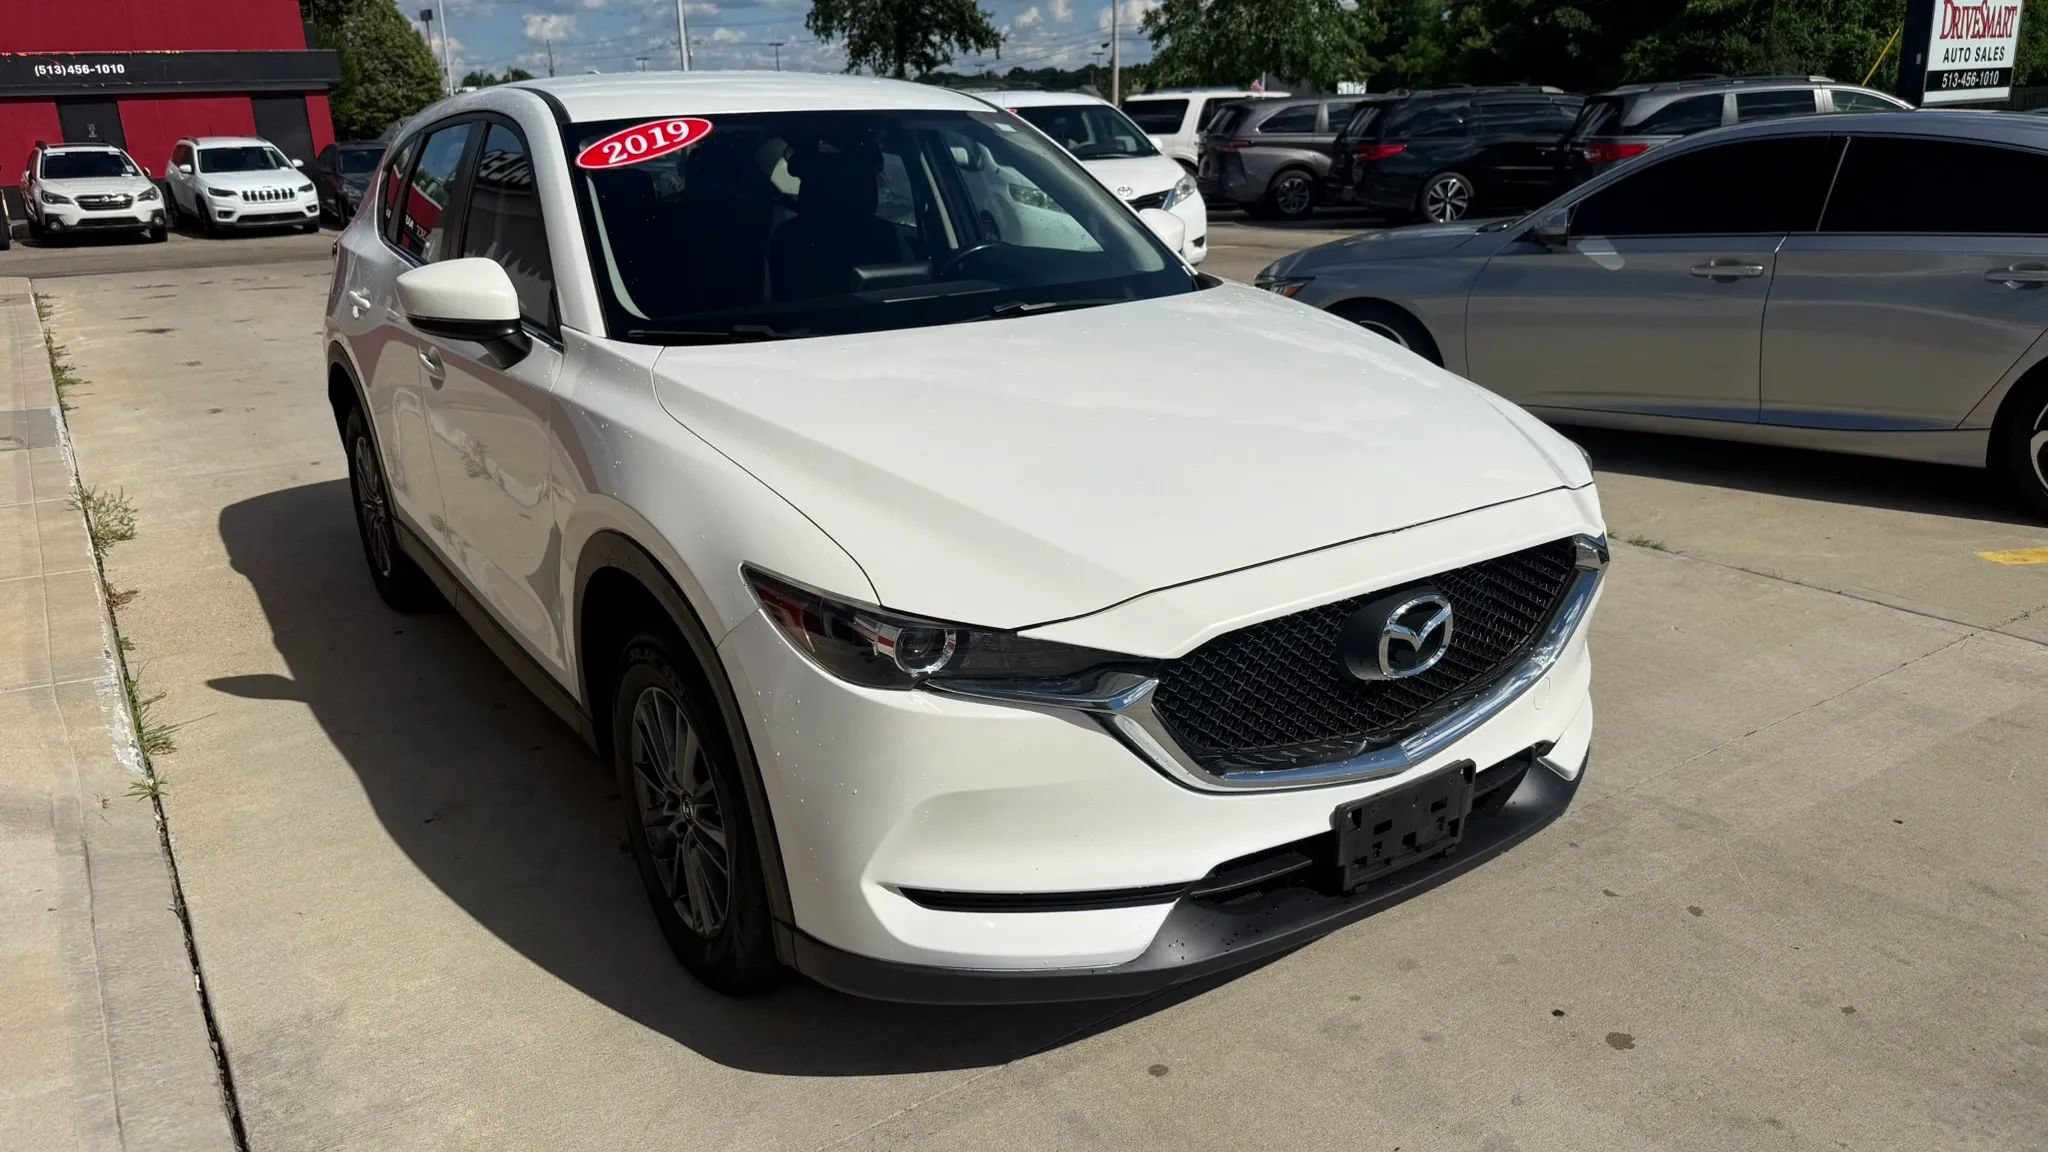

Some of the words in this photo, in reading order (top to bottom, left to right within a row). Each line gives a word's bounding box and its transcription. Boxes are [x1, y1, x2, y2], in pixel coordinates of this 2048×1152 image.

[1943, 47, 1971, 64] AUTO
[1974, 46, 2005, 62] SALES
[1941, 70, 2000, 89] 513-456-1010
[602, 120, 690, 165] 2019
